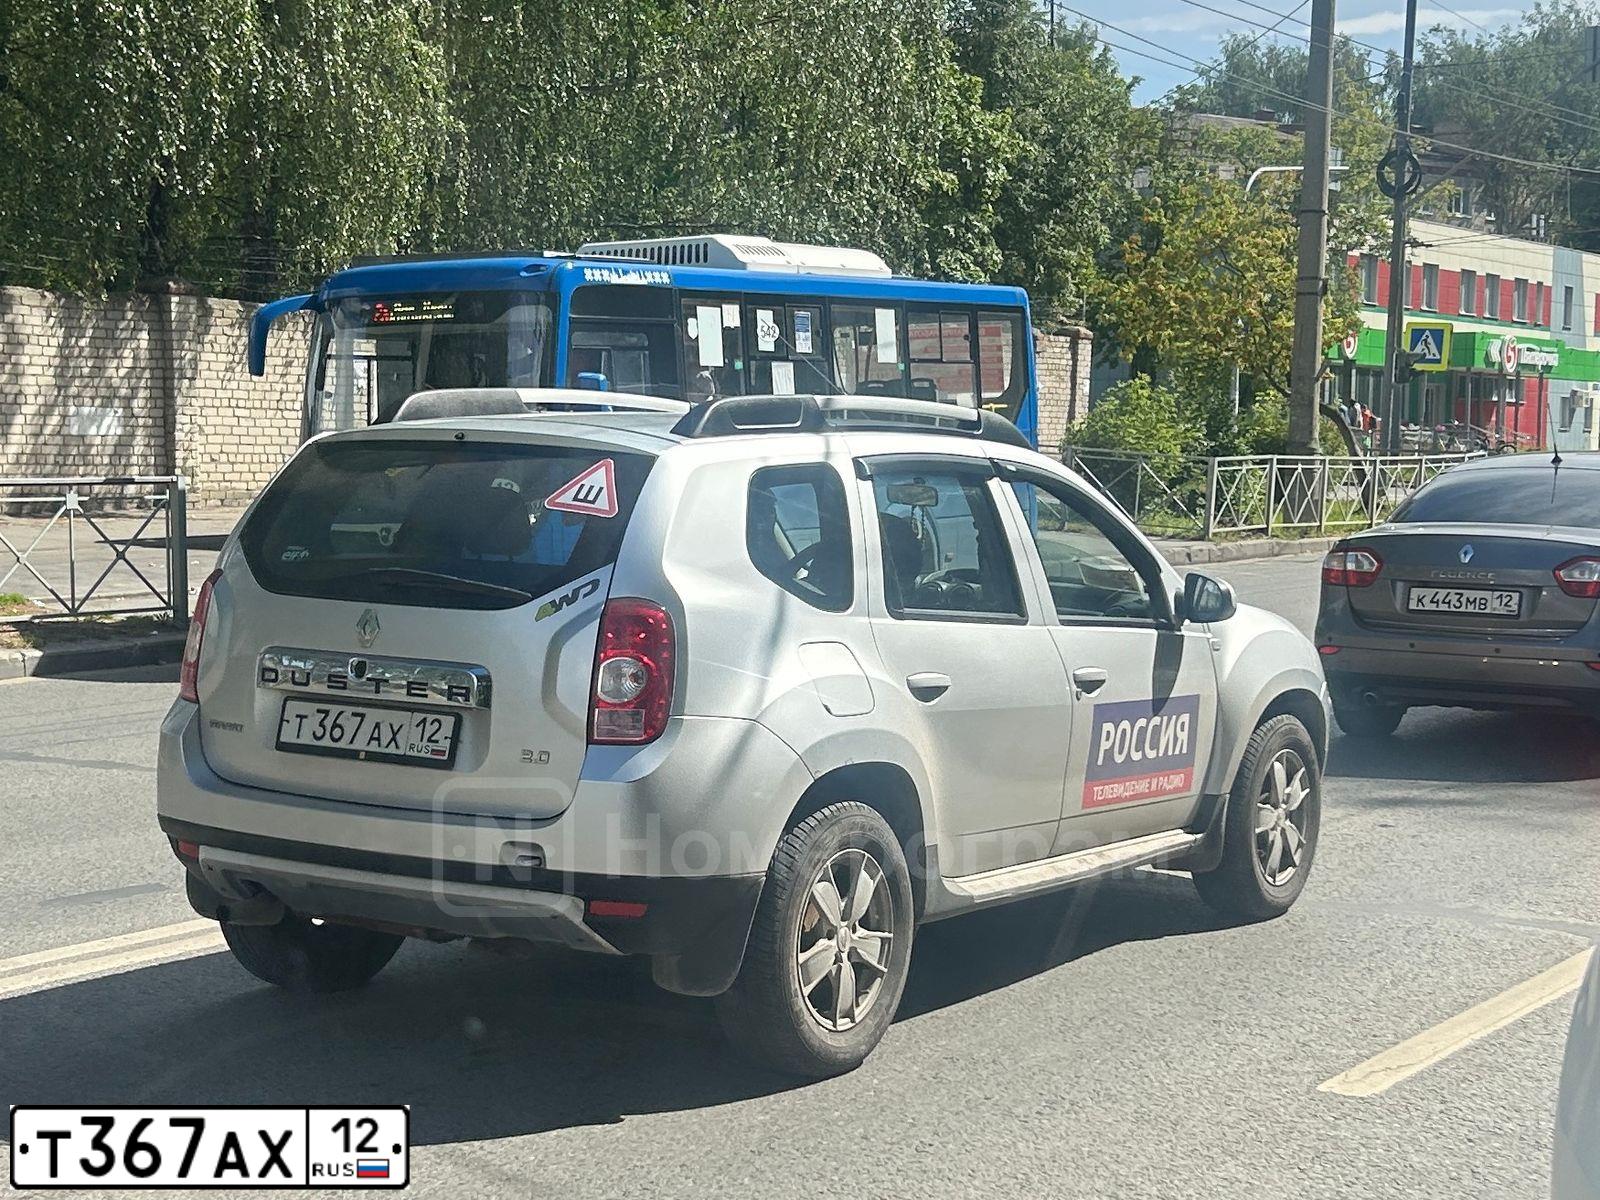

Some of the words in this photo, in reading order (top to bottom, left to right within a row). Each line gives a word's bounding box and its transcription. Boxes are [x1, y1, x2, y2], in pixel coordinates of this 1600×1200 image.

[572, 483, 604, 505] Ш
[1415, 591, 1489, 612] К443МВ
[1495, 593, 1514, 608] 12
[261, 666, 472, 703] DUSTER
[295, 708, 403, 750] Т367АХ
[415, 717, 441, 744] 12
[1097, 713, 1190, 766] РОССИЯ
[408, 742, 431, 755] RUS
[1093, 778, 1150, 801] ТЕЛЕВИДЕНИЕ
[1150, 776, 1158, 792] И
[1158, 773, 1185, 792] РАДИО
